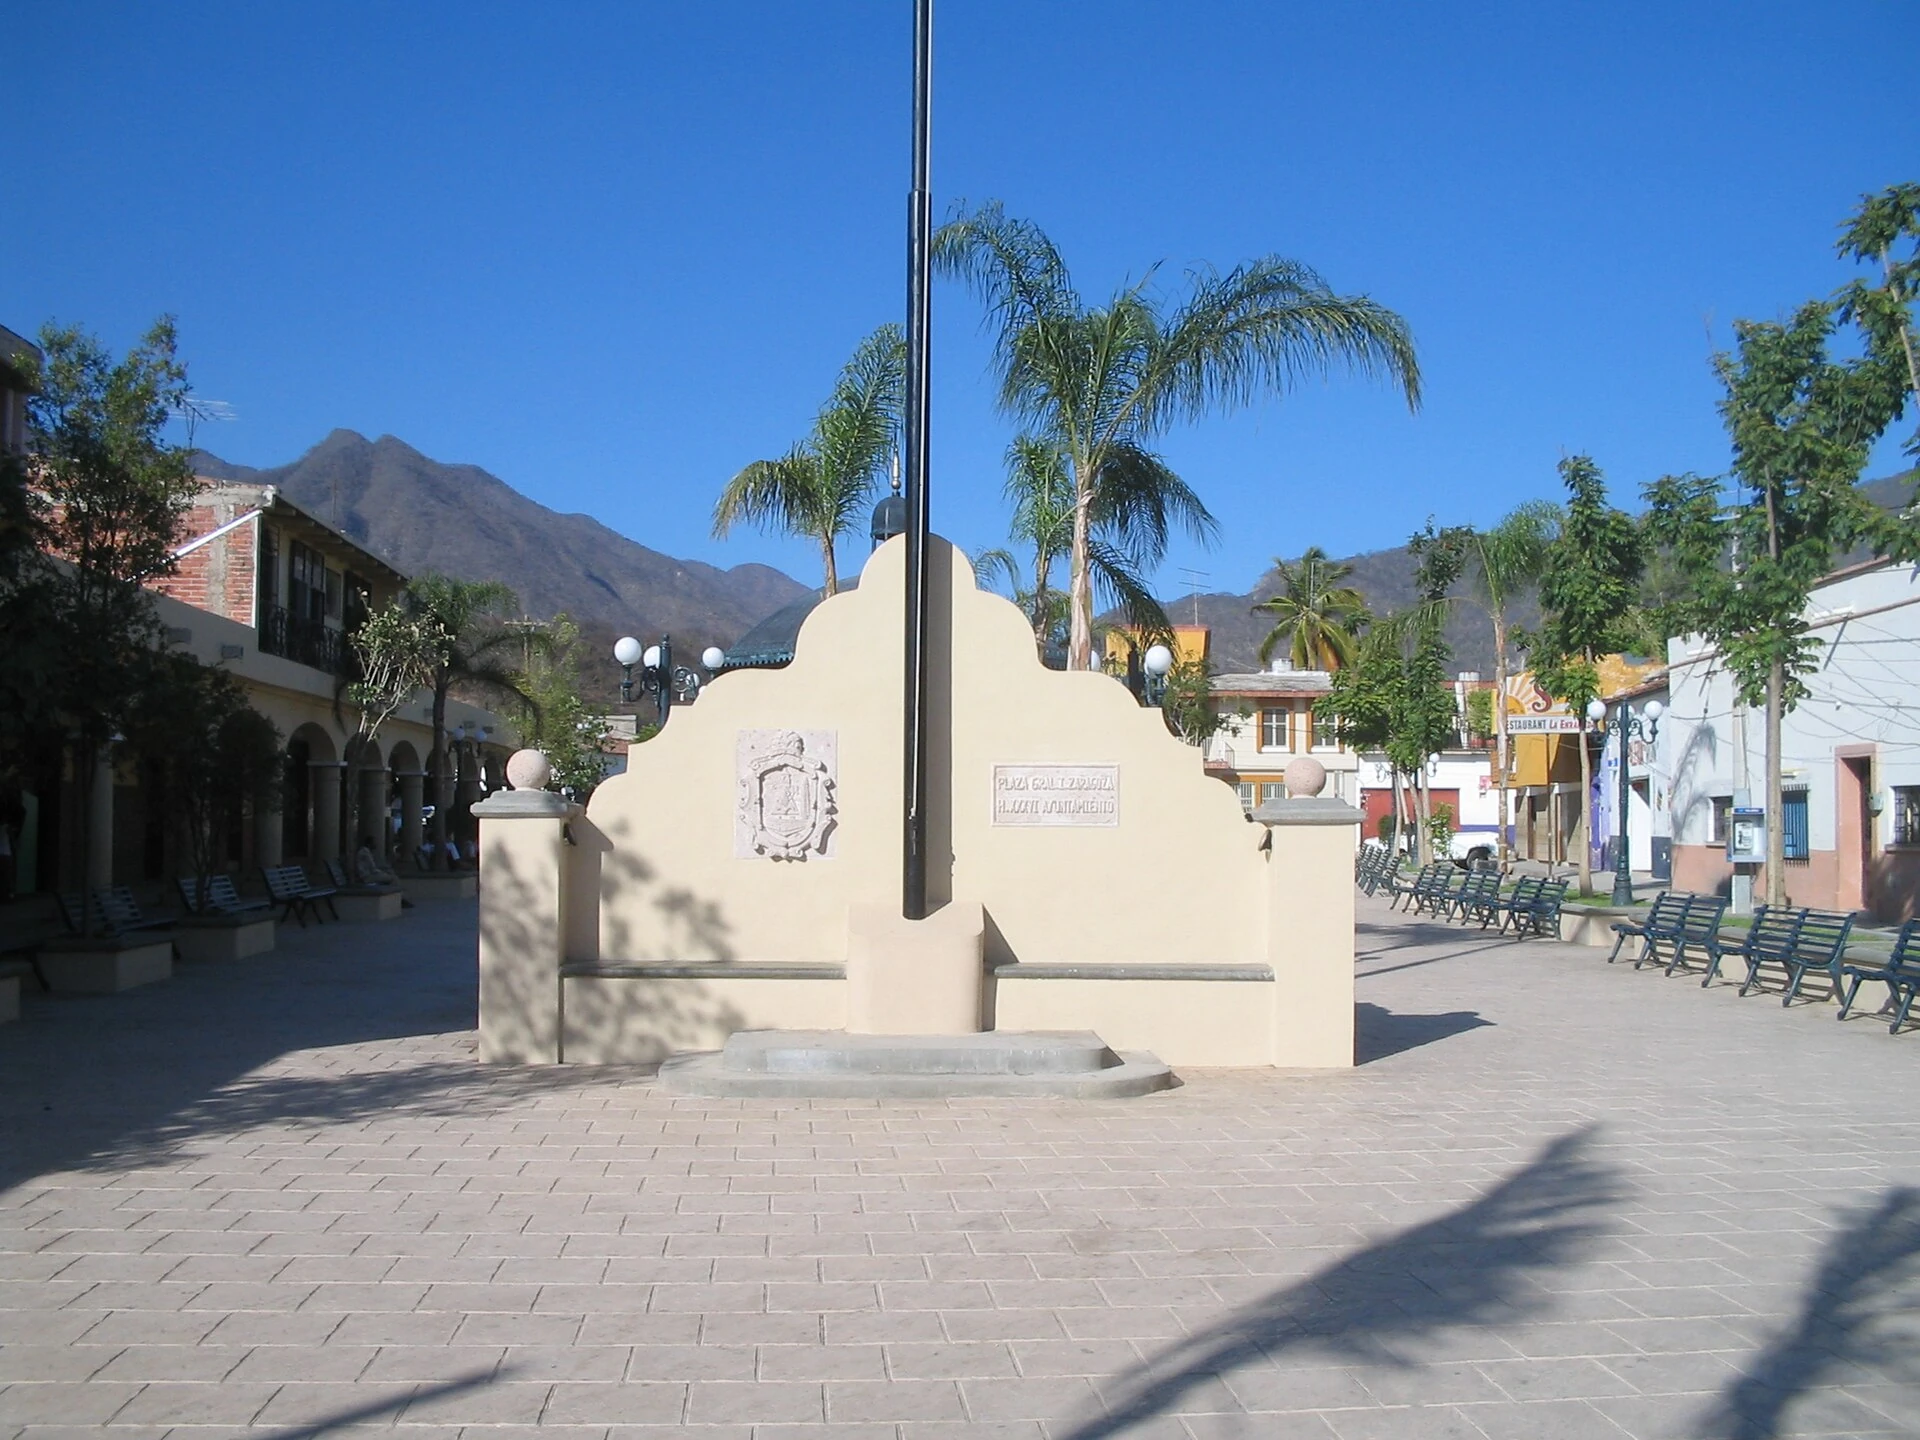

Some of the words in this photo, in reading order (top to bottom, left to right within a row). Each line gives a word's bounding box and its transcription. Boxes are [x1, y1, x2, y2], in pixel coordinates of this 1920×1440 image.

[1506, 719, 1546, 730] ESTAURANT
[997, 776, 1030, 791] PLAZA
[1068, 775, 1115, 791] ZARAGOZA
[1042, 799, 1115, 814] AYUNTAMIENTO
